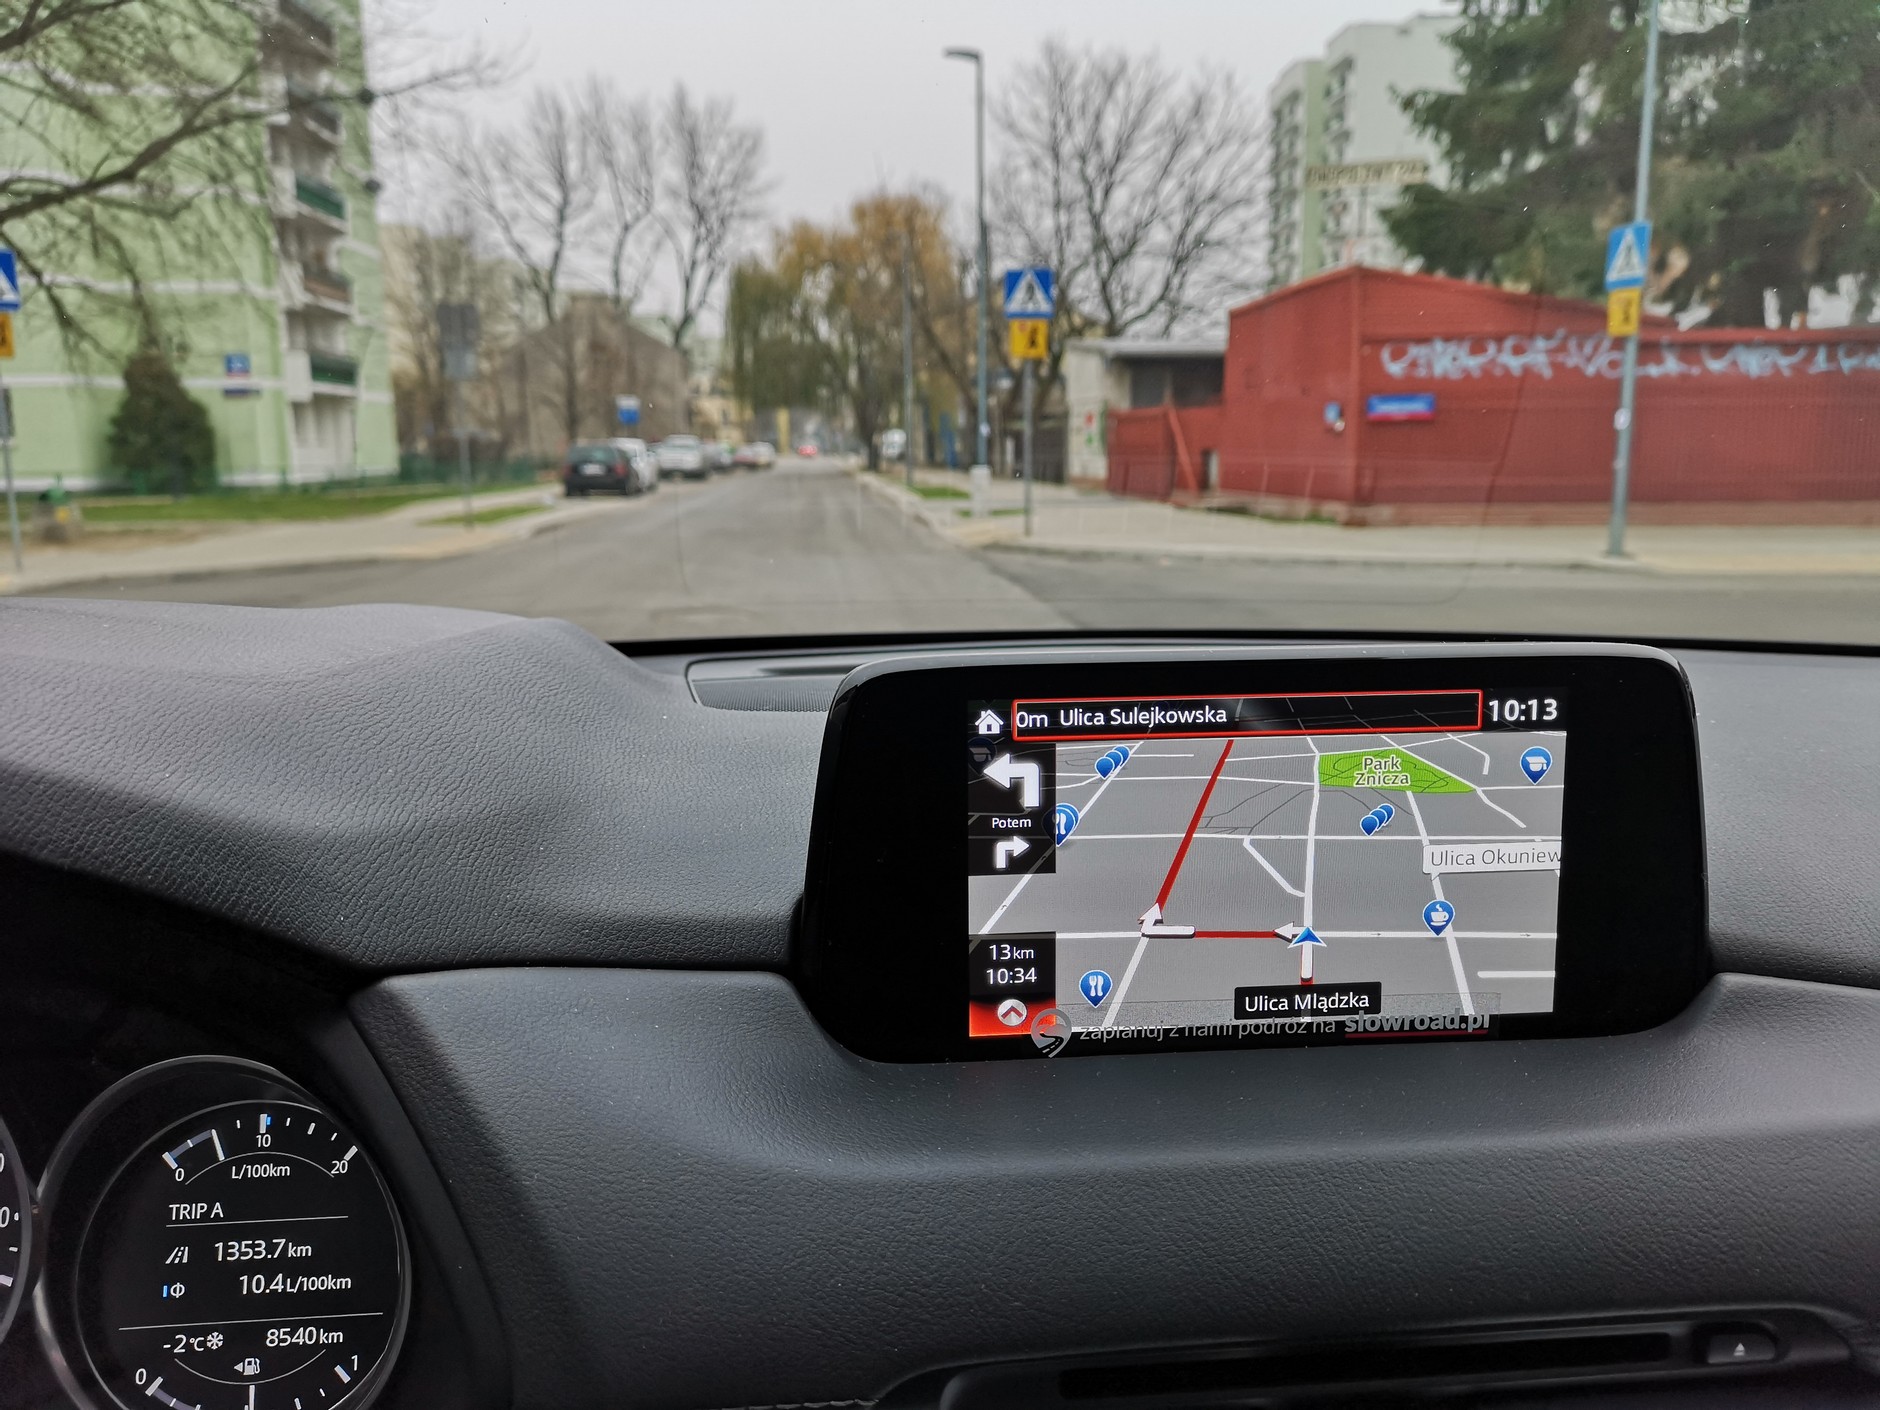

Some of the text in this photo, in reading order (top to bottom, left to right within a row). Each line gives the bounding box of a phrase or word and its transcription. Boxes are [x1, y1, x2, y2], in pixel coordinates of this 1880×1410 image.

[1016, 704, 1228, 728] 0m Ulica Sulejkowska
[1488, 698, 1558, 722] 10:13
[1363, 757, 1401, 771] Park
[1355, 772, 1410, 786] Znicza
[992, 817, 1032, 829] Potem
[1431, 850, 1475, 867] Ulica
[986, 966, 1037, 985] 10:34
[1245, 991, 1370, 1013] Ulica Mlądzka
[256, 1134, 271, 1148] 10
[174, 1167, 185, 1182] 0
[231, 1163, 290, 1180] L/100km
[331, 1160, 348, 1174] 20
[169, 1202, 224, 1220] TRIP A
[135, 1368, 147, 1384] 0
